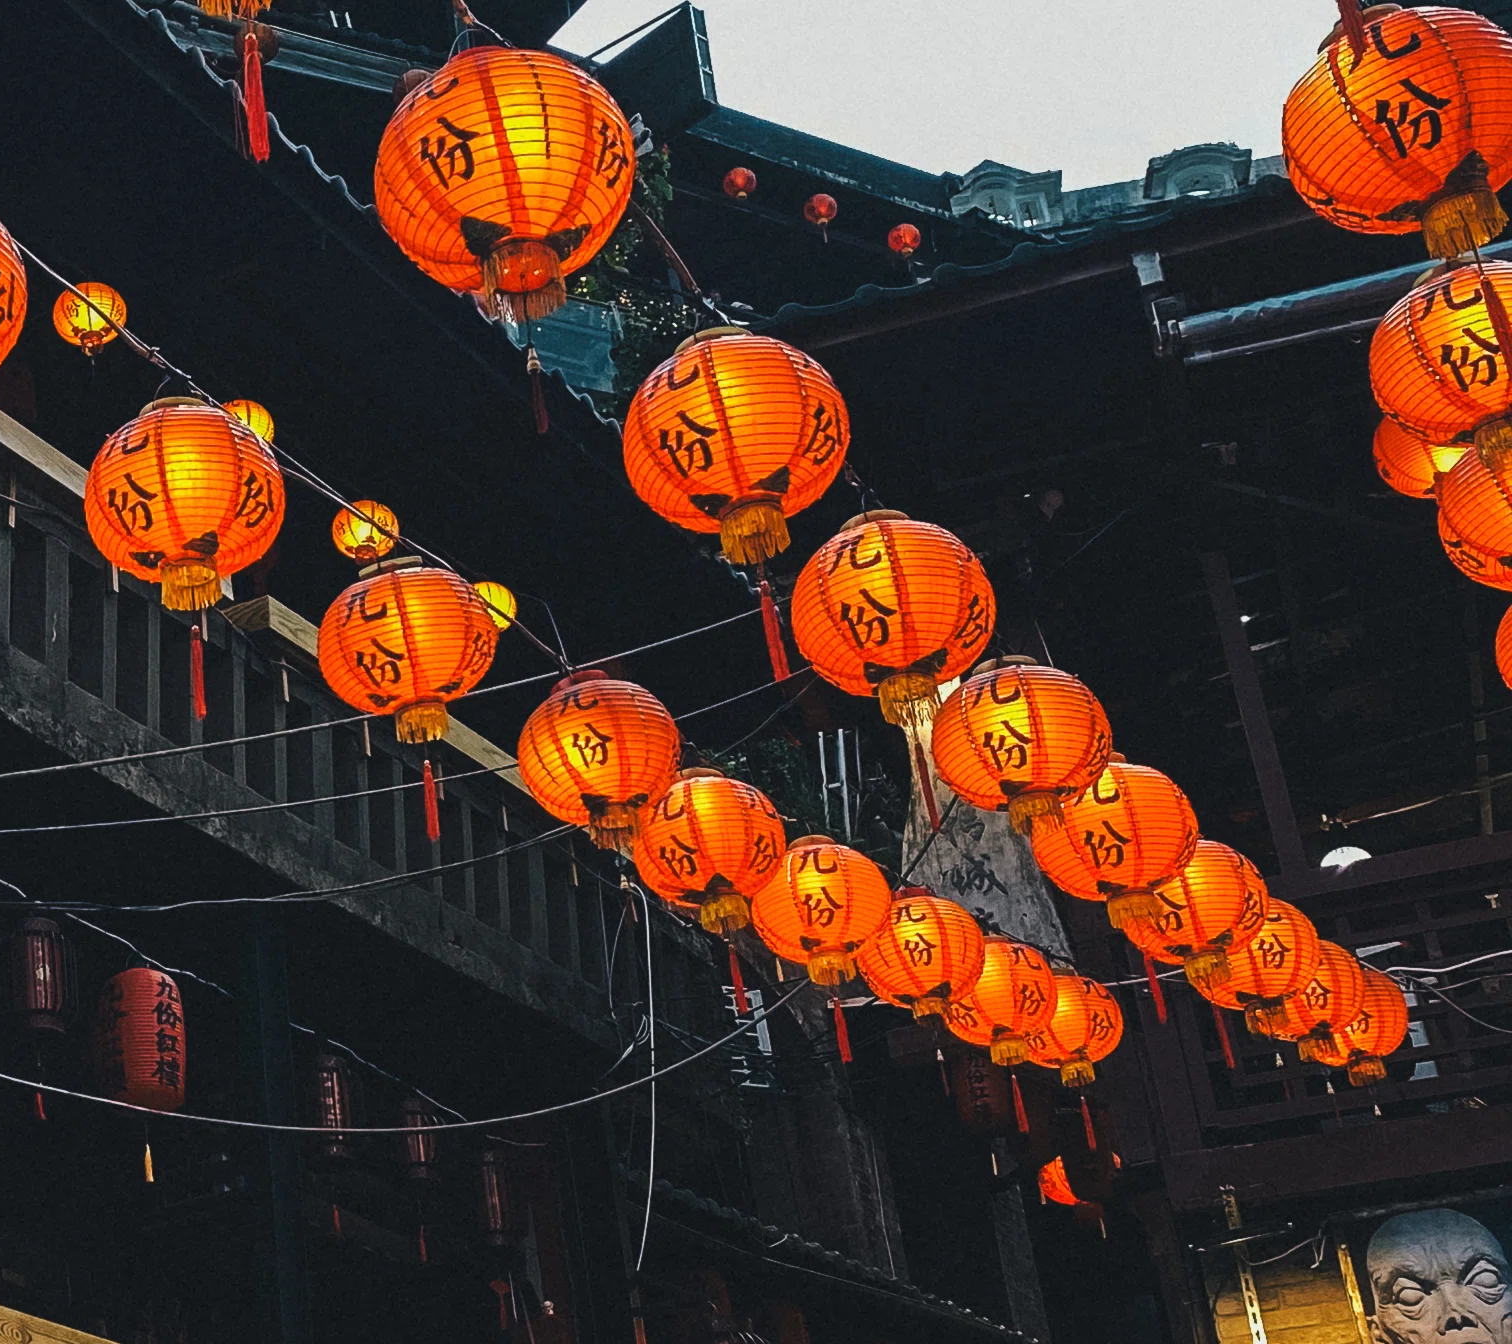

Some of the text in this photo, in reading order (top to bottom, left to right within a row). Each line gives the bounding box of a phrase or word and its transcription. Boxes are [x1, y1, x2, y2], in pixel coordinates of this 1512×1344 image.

[340, 587, 406, 689] 九份
[825, 536, 898, 652] 九份
[970, 670, 1033, 773] 九份
[797, 845, 844, 929] 九份
[892, 902, 936, 968] 九份
